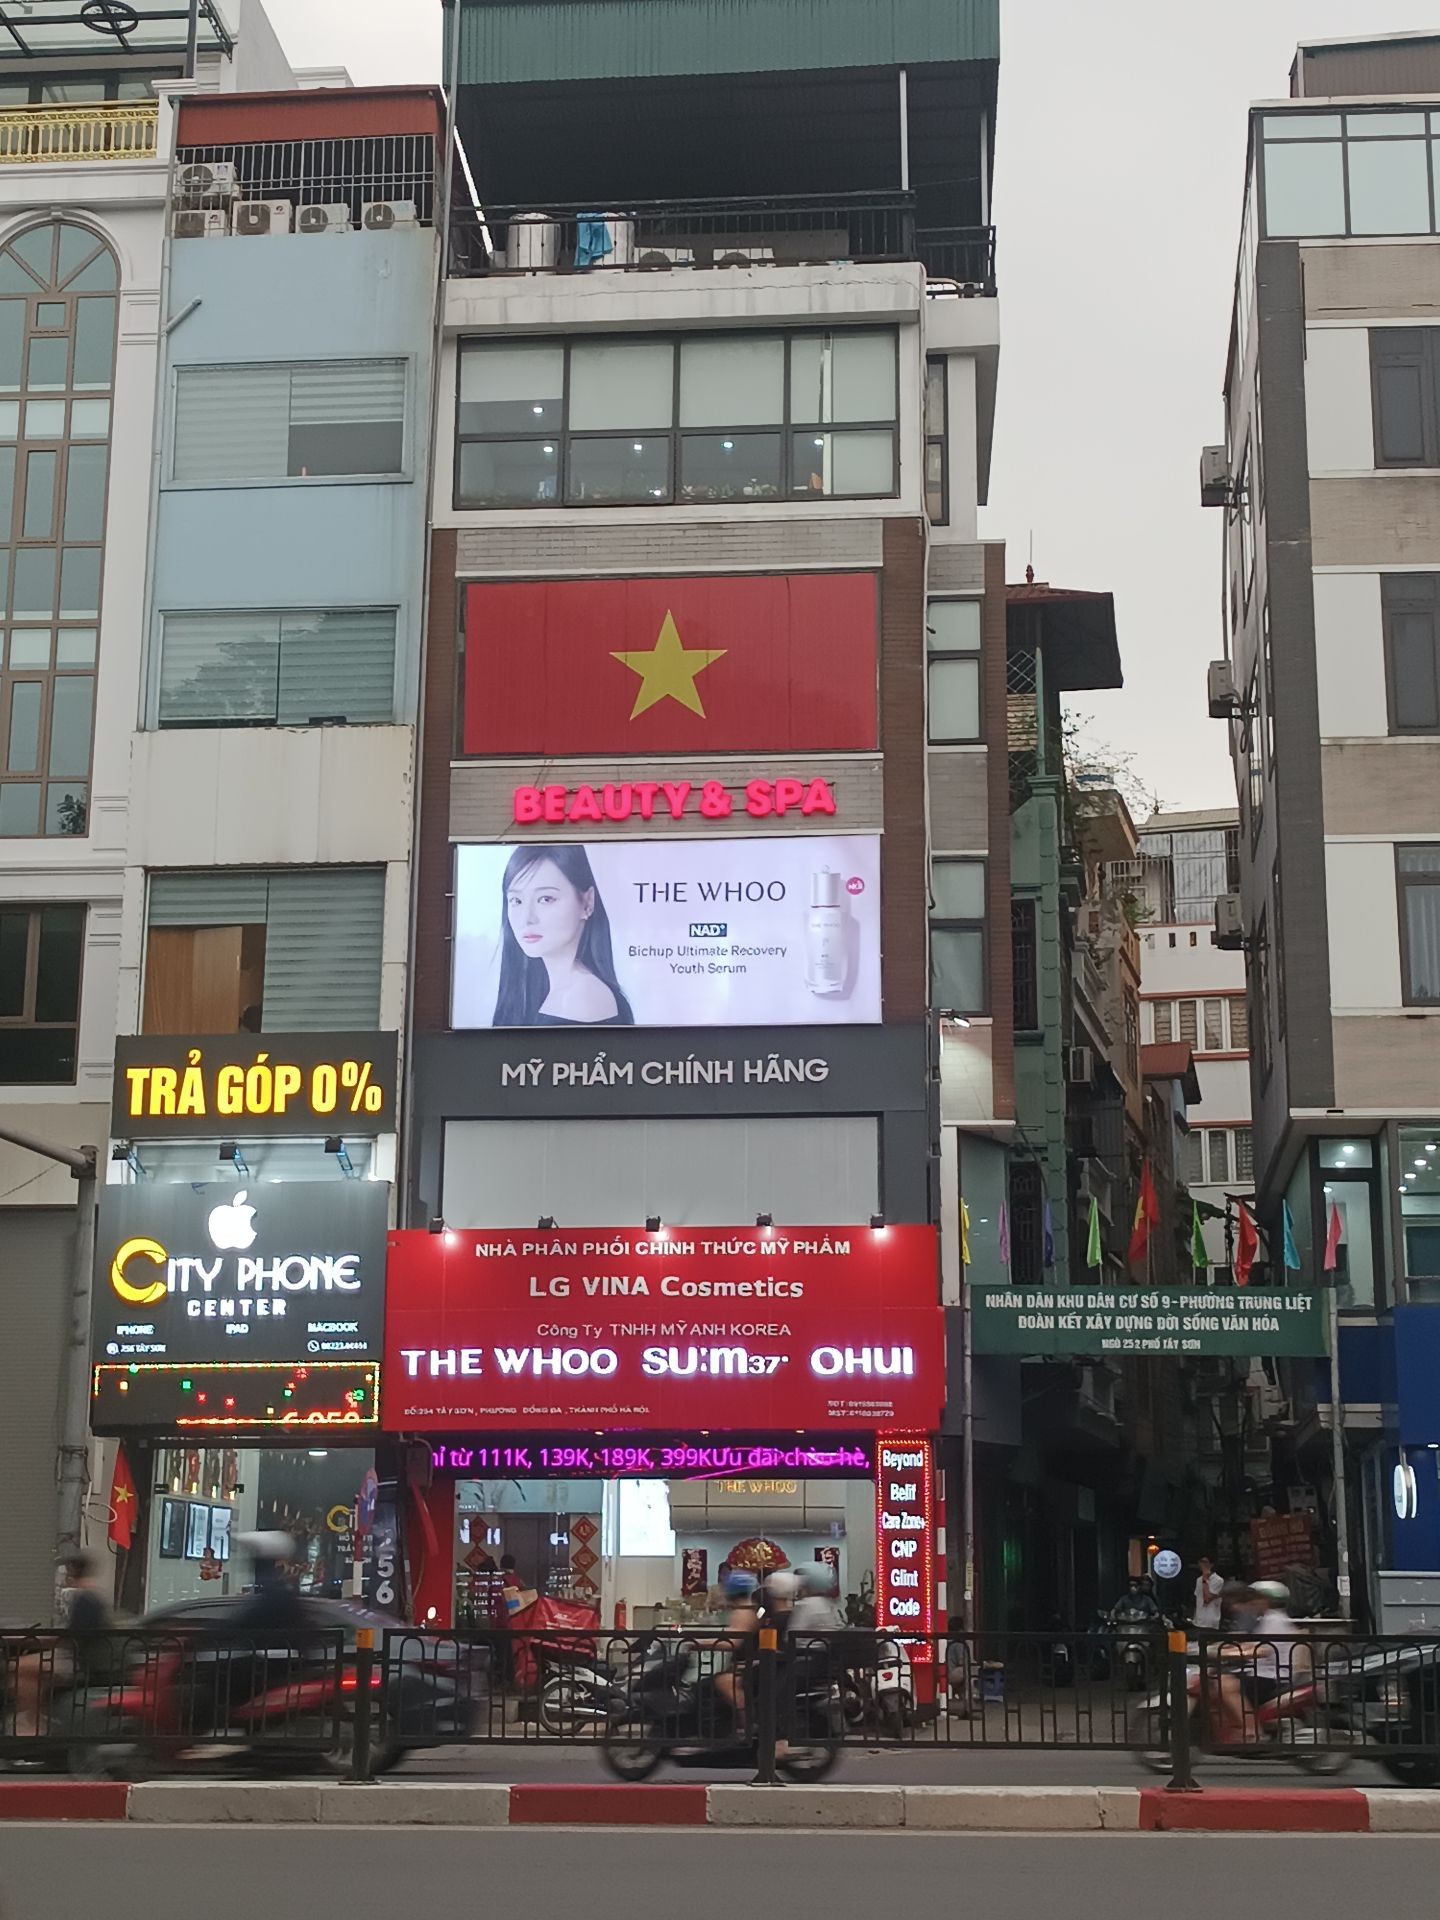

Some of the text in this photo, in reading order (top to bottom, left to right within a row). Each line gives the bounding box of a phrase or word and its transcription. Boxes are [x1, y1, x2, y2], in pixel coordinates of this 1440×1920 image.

[514, 778, 836, 824] BEAUTY & SPA
[633, 881, 787, 903] THE WHOO
[628, 945, 787, 958] Bichup Ultimate Recovery
[670, 962, 746, 974] Youth Serum
[501, 1051, 829, 1086] MỸ PHẨM CHÍNH HÃNG
[126, 1049, 382, 1115] TRẢ GÓP 0%
[475, 1239, 517, 1257] NHÀ
[522, 1239, 577, 1256] PHÂN
[583, 1236, 630, 1255] PHỐI
[701, 1237, 756, 1254] THỨC
[760, 1238, 790, 1254] MỸ
[111, 1238, 361, 1304] CITY PHONE
[530, 1276, 804, 1297] LG VINA Cosmetics
[187, 1298, 287, 1316] CENTER
[985, 1292, 1023, 1308] NHÂN
[1026, 1292, 1054, 1308] DÂN
[1057, 1294, 1084, 1308] KHU
[1087, 1292, 1115, 1308] DÂN
[1119, 1293, 1139, 1308] CƯ
[1141, 1291, 1160, 1308] SỐ
[1237, 1296, 1282, 1310] TRUNG
[1285, 1293, 1313, 1313] LIỆT
[537, 1320, 791, 1338] Công Ty TNHH MỸ ANH KOREA
[1018, 1311, 1280, 1332] ĐOÀN KẾT XÂY DỰNG ĐỜI SỐNG VĂN HÓA
[1163, 1337, 1178, 1349] TÂY
[1182, 1339, 1201, 1349] SƠN
[400, 1348, 483, 1376] THE
[493, 1348, 618, 1375] WHOO
[810, 1347, 913, 1375] OHUI
[450, 1446, 473, 1466] từ
[479, 1448, 532, 1468] 111K,
[540, 1448, 593, 1468] 139K,
[601, 1448, 655, 1468] 189K,
[748, 1446, 778, 1466] đãi
[840, 1446, 870, 1468] hè,
[882, 1450, 923, 1471] Beyond
[750, 1480, 798, 1493] WHOO
[890, 1483, 917, 1501] Belif
[891, 1540, 917, 1557] CNP
[890, 1569, 918, 1586] Glint
[889, 1597, 920, 1616] Code
